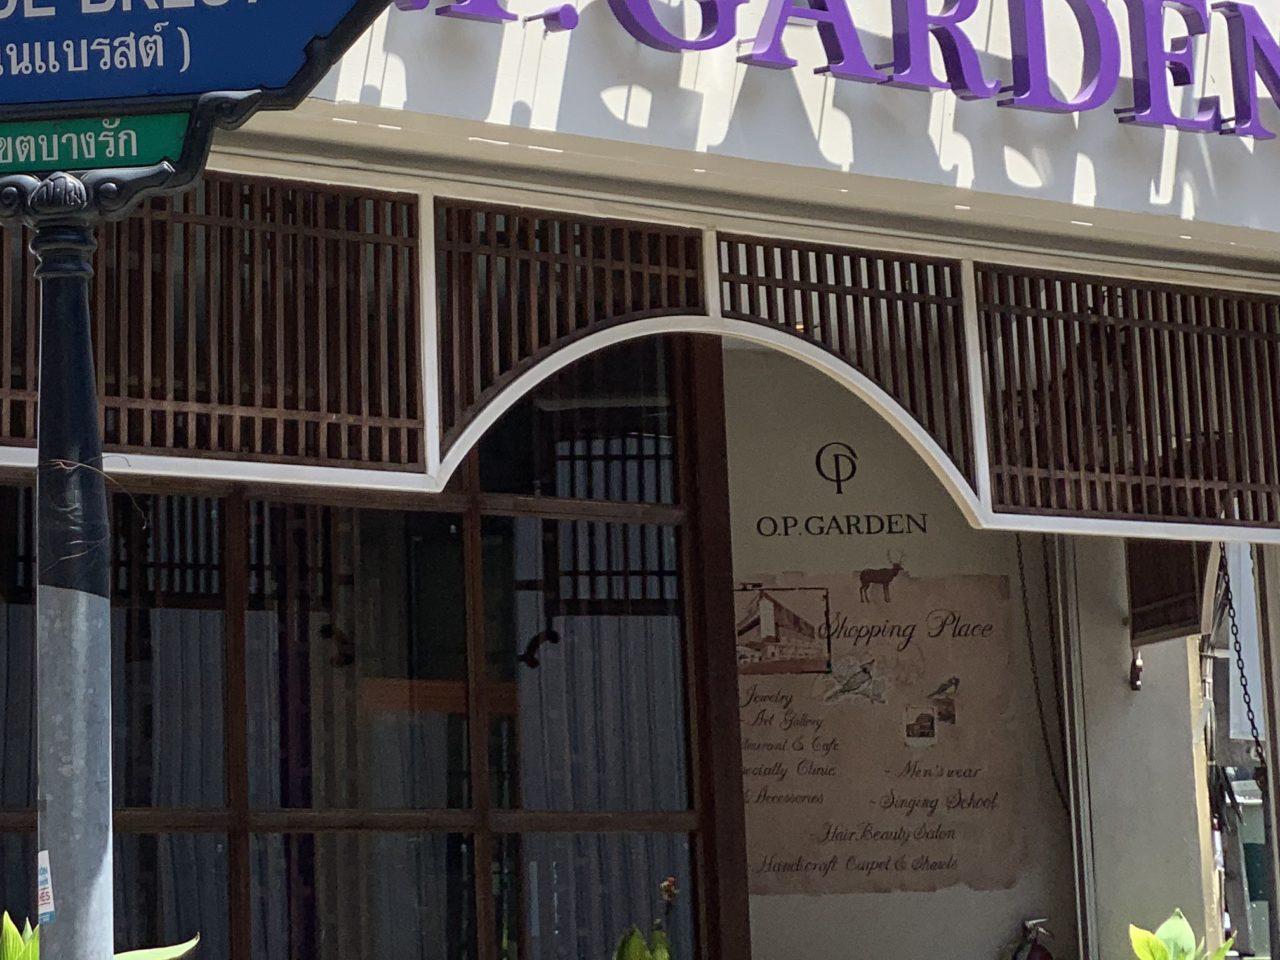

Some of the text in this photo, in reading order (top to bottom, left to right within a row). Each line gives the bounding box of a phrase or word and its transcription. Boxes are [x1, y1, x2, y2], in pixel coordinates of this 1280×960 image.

[819, 609, 993, 652] Shopping Place
[780, 709, 824, 732] Gallery
[754, 786, 824, 804] Accessories
[947, 790, 999, 810] School
